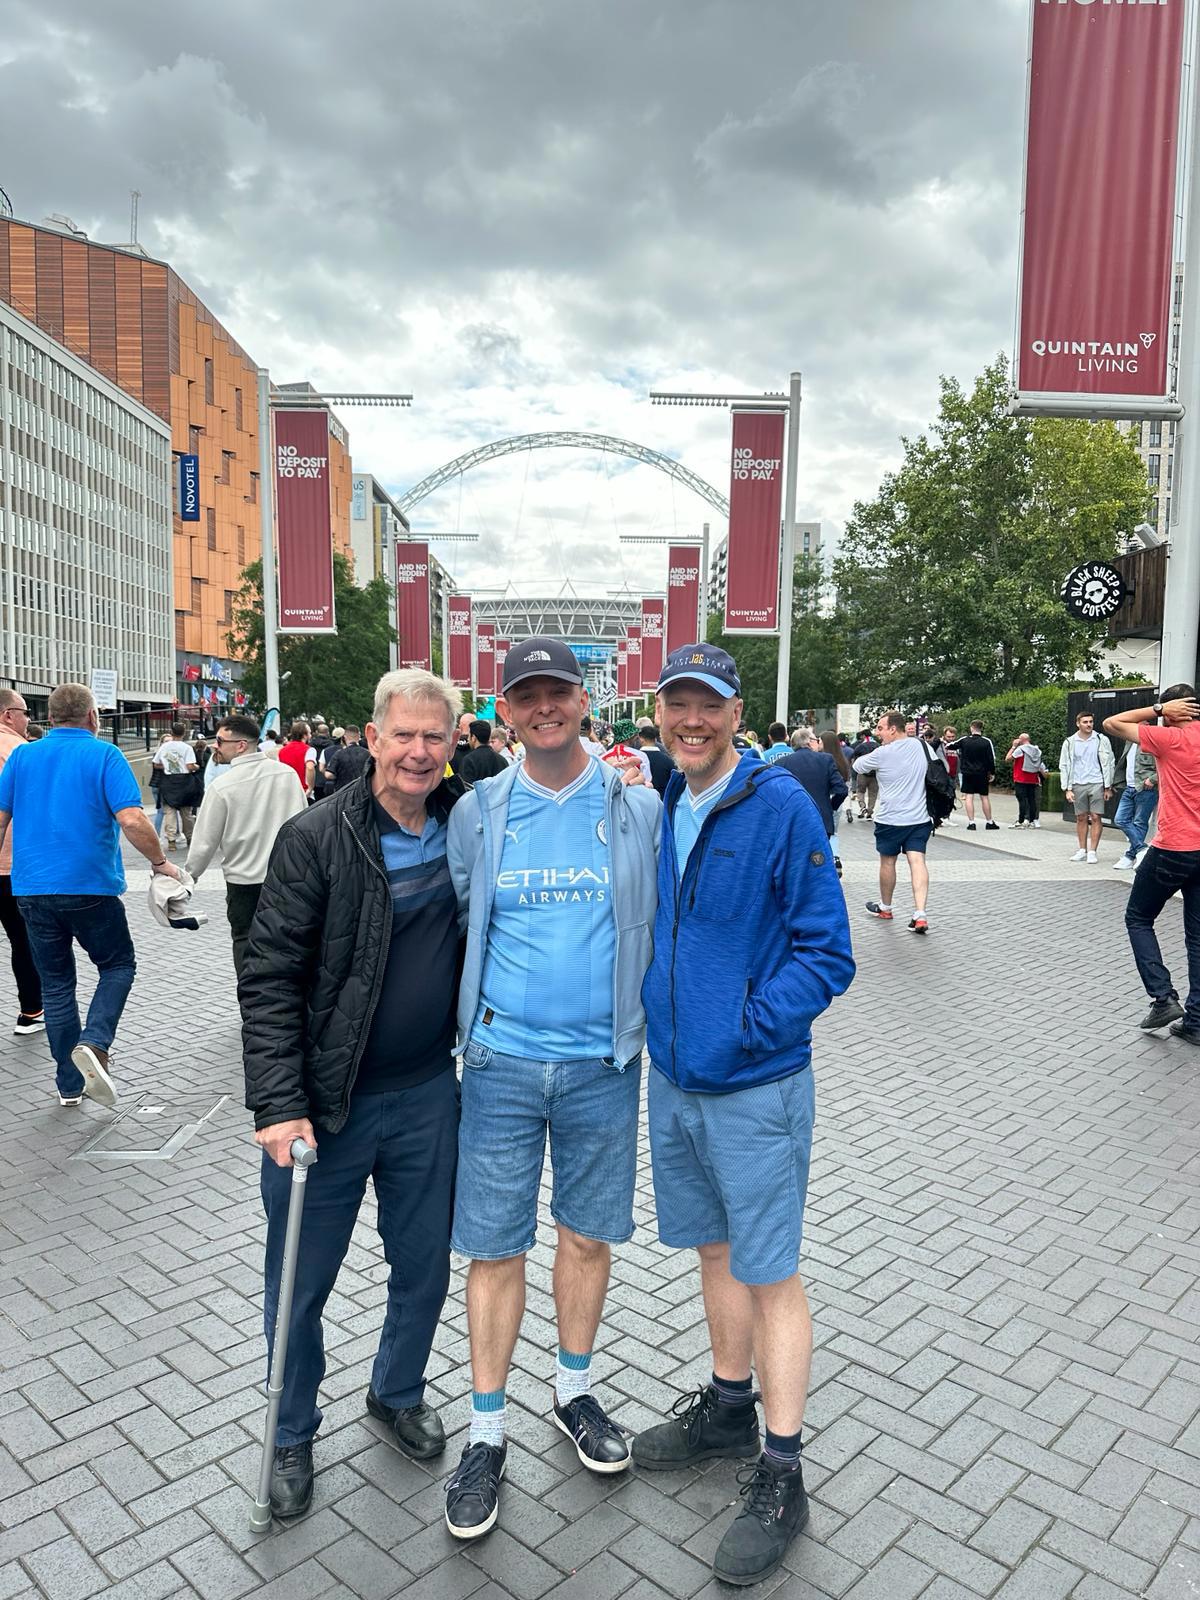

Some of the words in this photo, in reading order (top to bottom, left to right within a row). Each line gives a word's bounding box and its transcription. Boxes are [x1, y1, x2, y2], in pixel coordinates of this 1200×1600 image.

[1032, 340, 1138, 356] QUINTAIN
[1078, 358, 1138, 373] LIVING
[278, 445, 298, 457] NO
[734, 448, 753, 459] NO
[278, 457, 327, 468] DEPOSIT
[734, 458, 781, 470] DEPOSIT
[278, 467, 296, 478] TO
[298, 468, 322, 478] PAY.
[733, 469, 749, 480] TO
[751, 470, 775, 481] PAY.
[185, 459, 195, 512] NOVOTEL
[399, 563, 415, 571] AND
[416, 563, 428, 571] NO
[671, 567, 686, 575] AND
[687, 567, 699, 575] NO
[1071, 568, 1092, 597] BLACK
[1093, 566, 1120, 587] SHEEP
[284, 608, 324, 616] QUINTAIN
[1082, 597, 1120, 617] COFFEE
[518, 890, 605, 905] AIRWAYS
